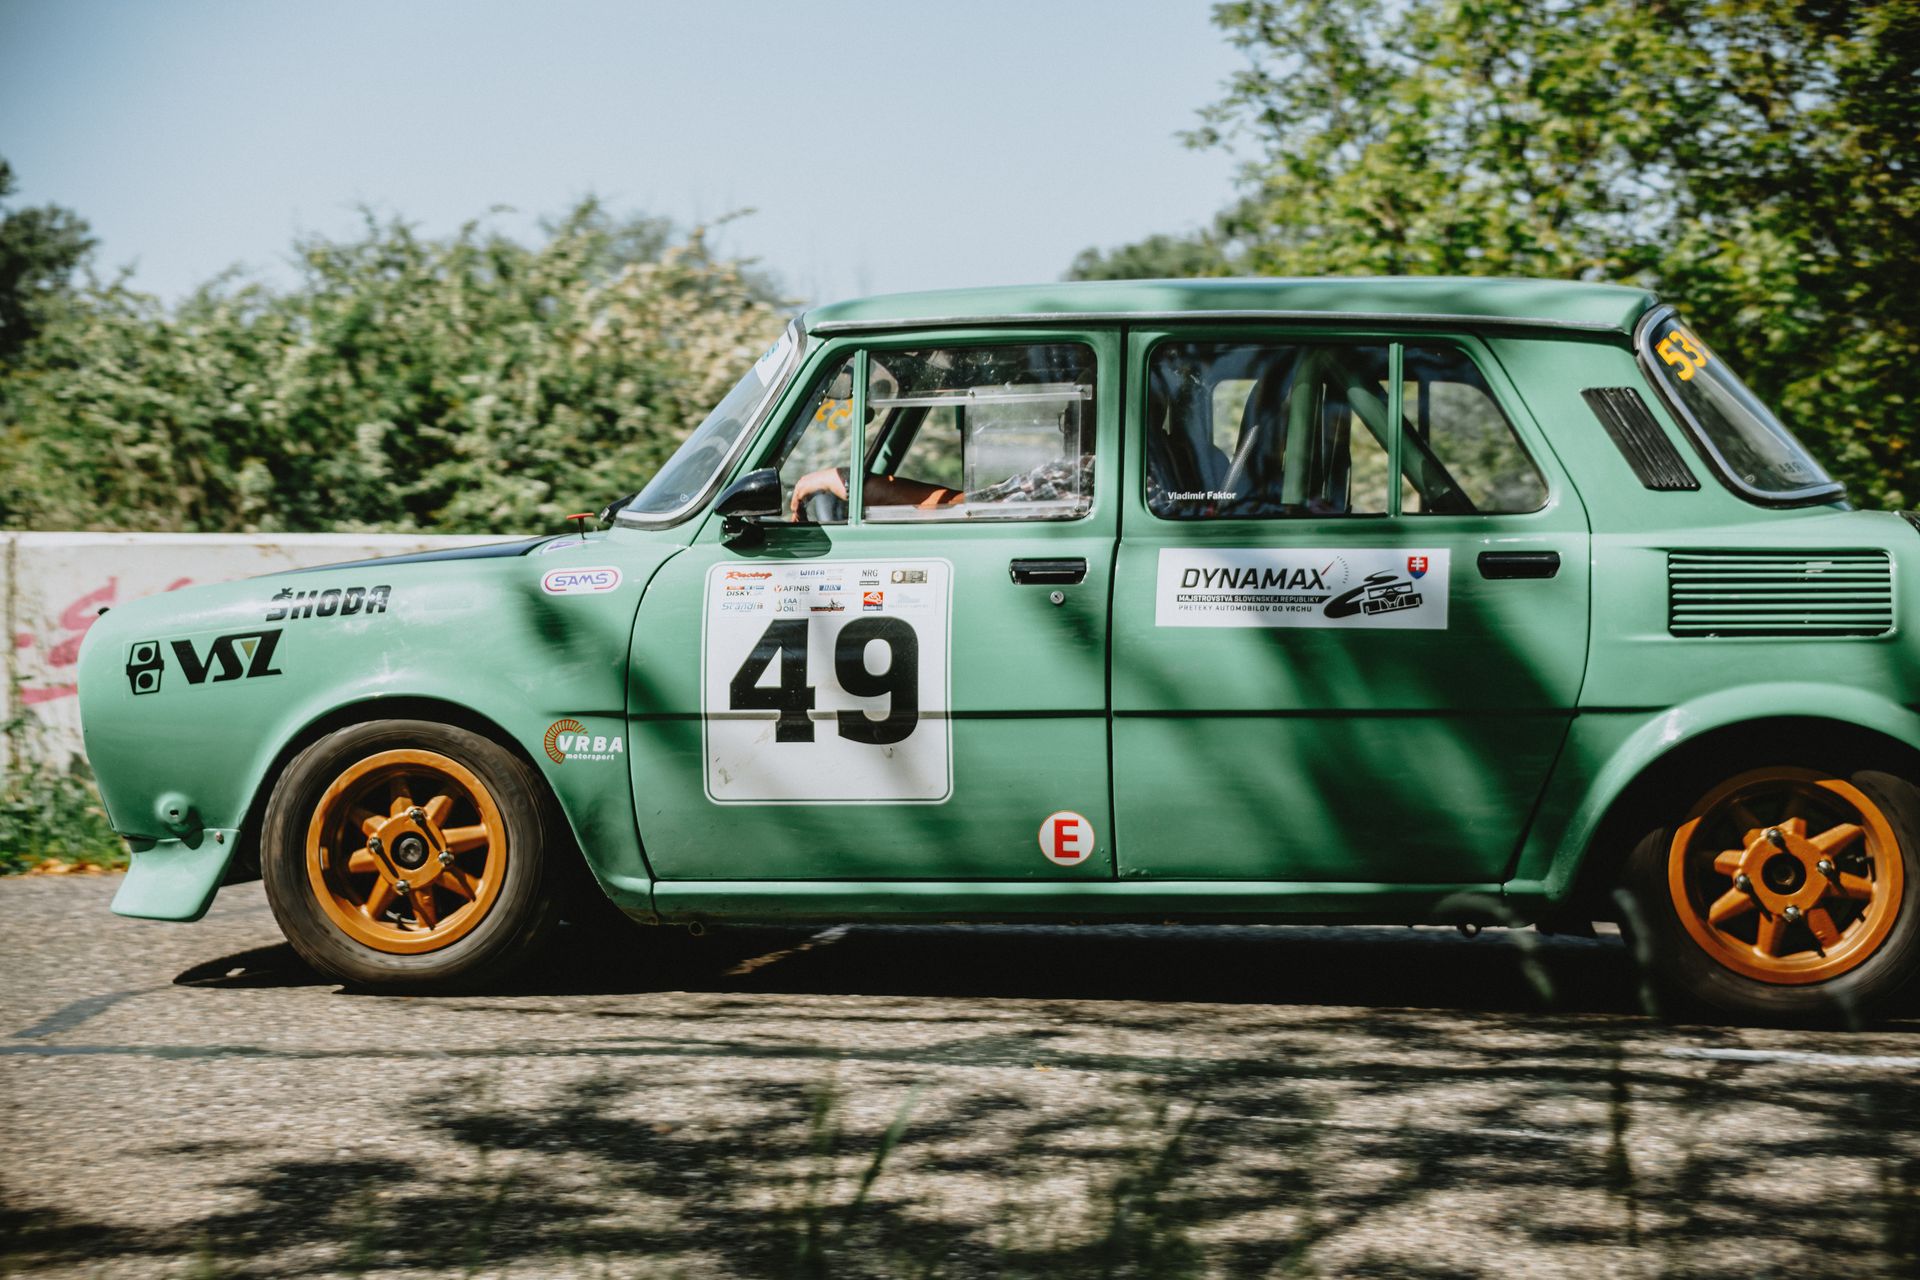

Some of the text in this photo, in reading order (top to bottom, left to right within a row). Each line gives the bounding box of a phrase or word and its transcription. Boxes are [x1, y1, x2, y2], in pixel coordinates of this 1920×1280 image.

[1207, 490, 1237, 500] Faktor
[1180, 568, 1325, 590] DYNAMAX
[1234, 595, 1279, 603] SLOVENSKEJ
[1280, 595, 1320, 603] REPUBLIKY
[1285, 605, 1312, 613] VRCHU
[729, 616, 919, 745] 49
[559, 735, 623, 753] VRBA
[1054, 819, 1080, 858] E
